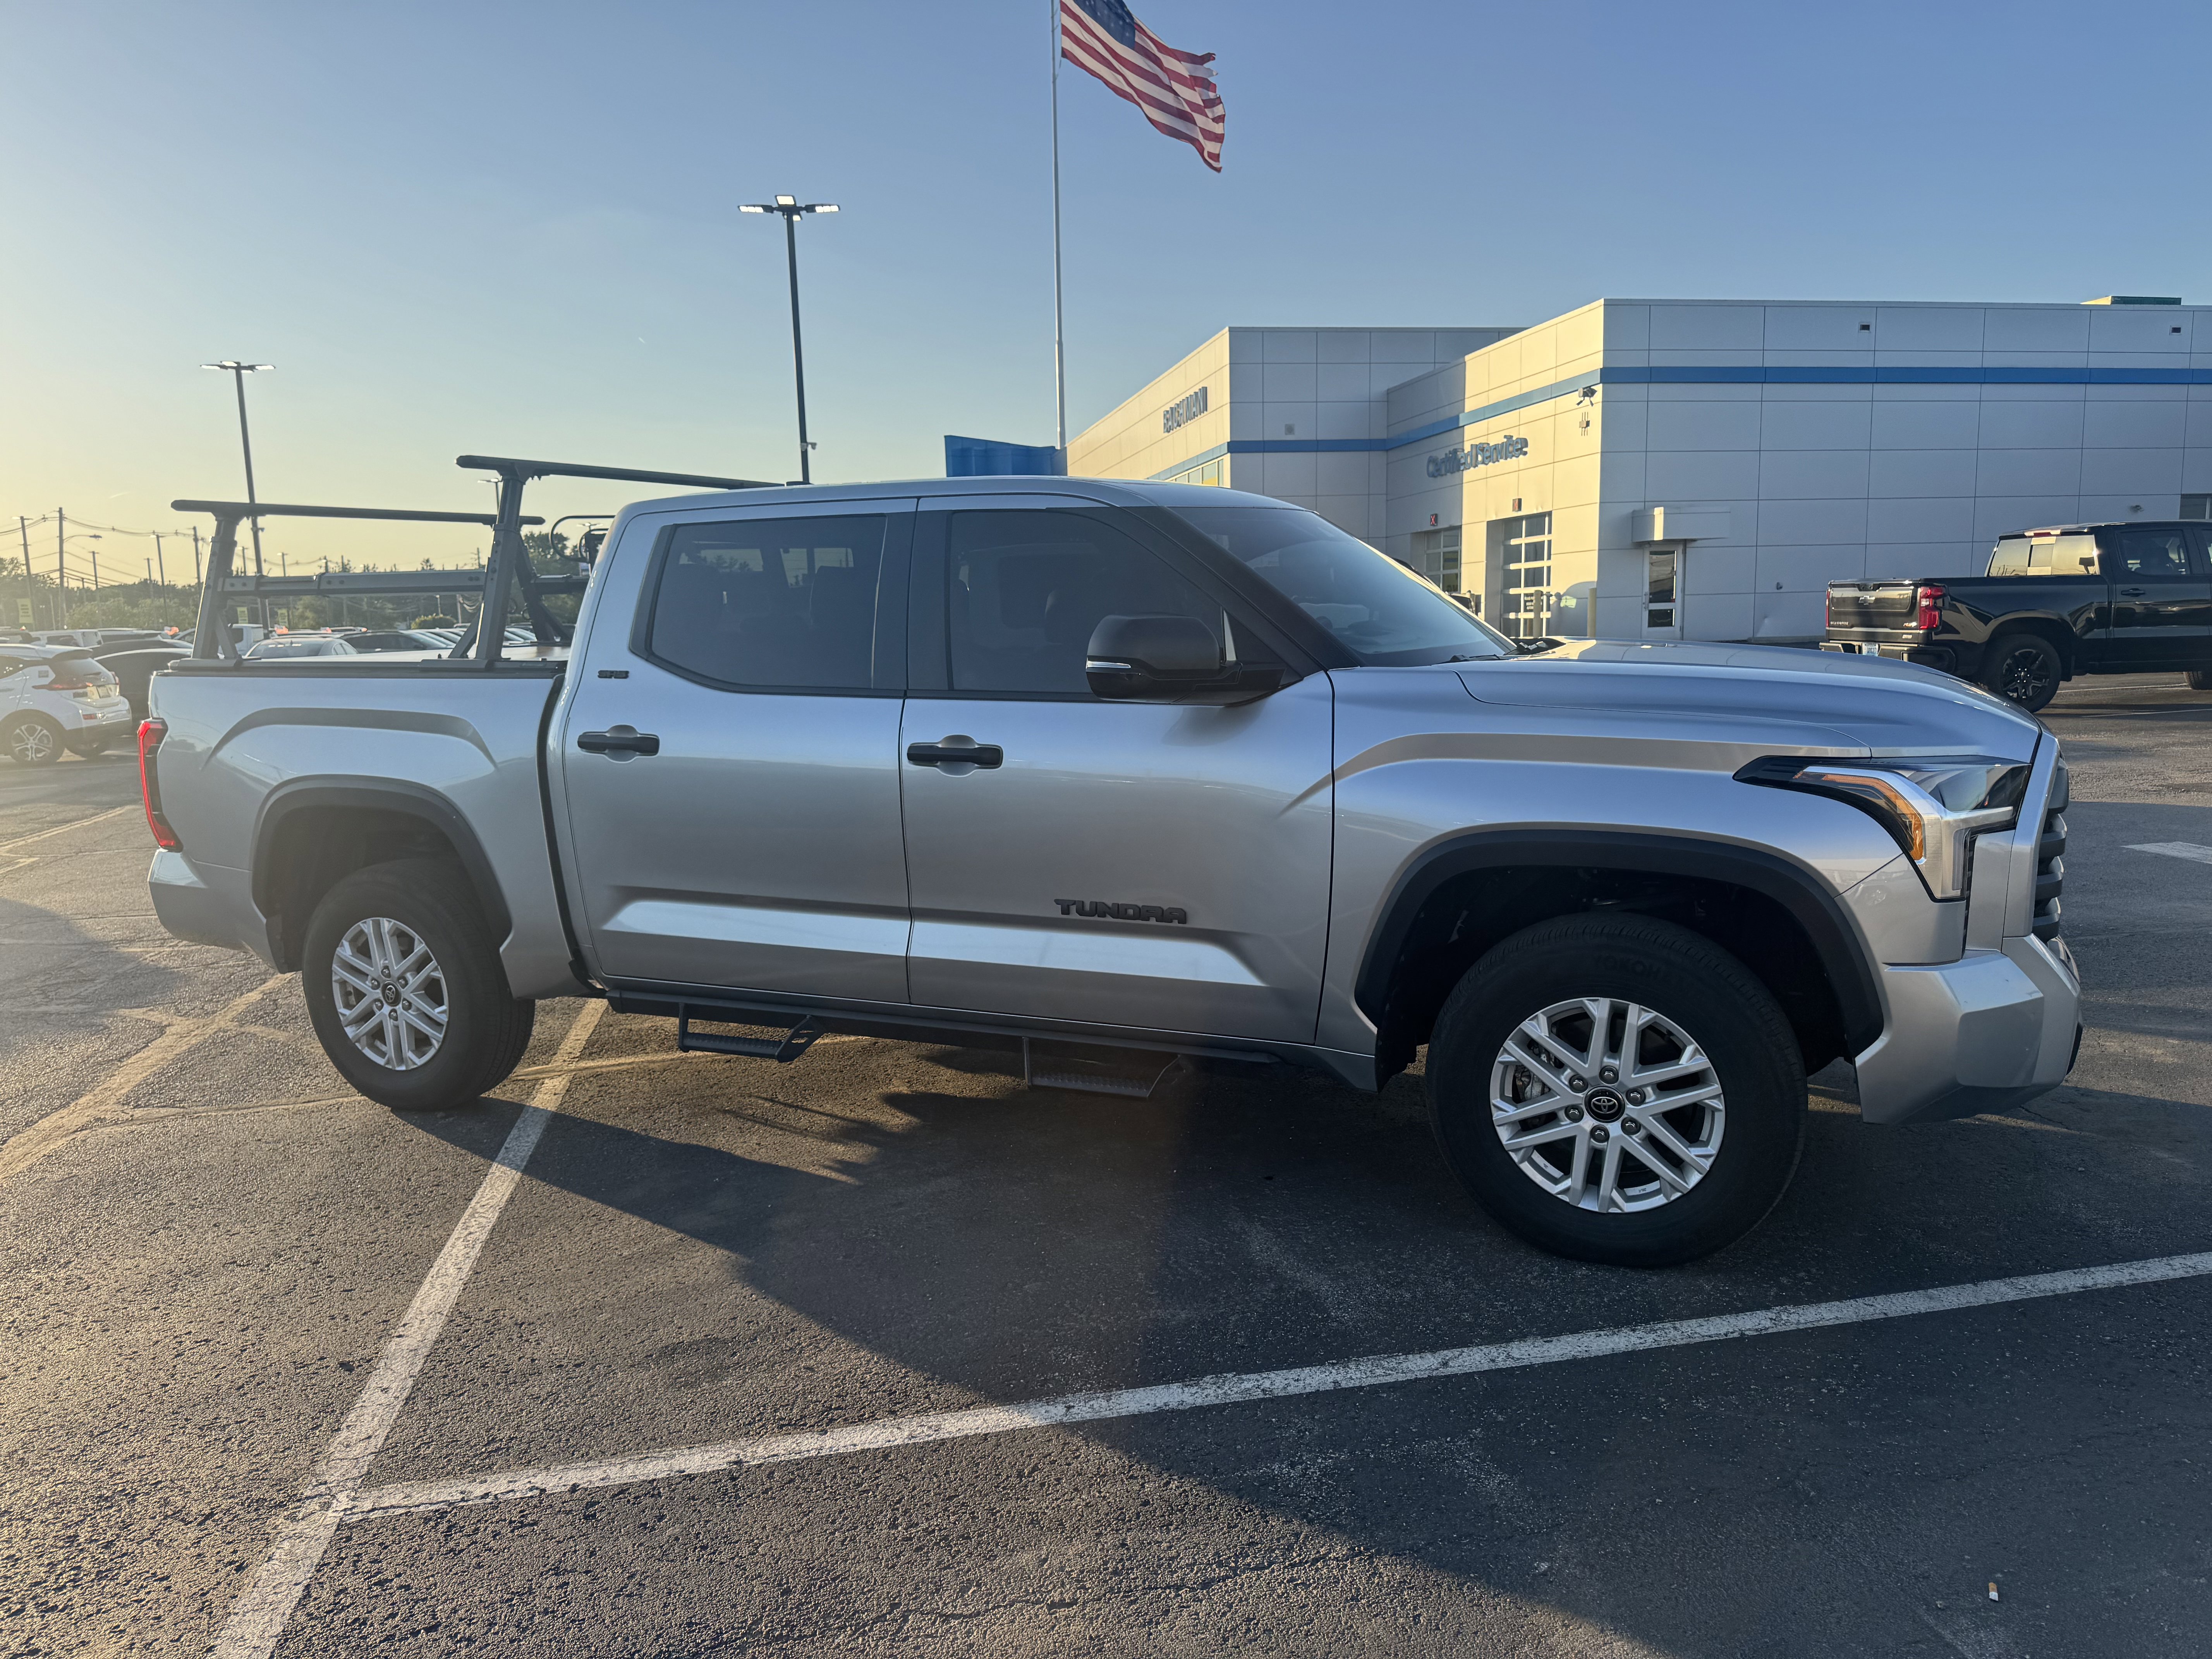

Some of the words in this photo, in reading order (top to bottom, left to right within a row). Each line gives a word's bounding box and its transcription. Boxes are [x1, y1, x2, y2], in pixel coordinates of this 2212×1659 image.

[1427, 444, 1478, 477] Certified
[1476, 435, 1528, 465] Service
[1054, 899, 1187, 924] TUNDRA
